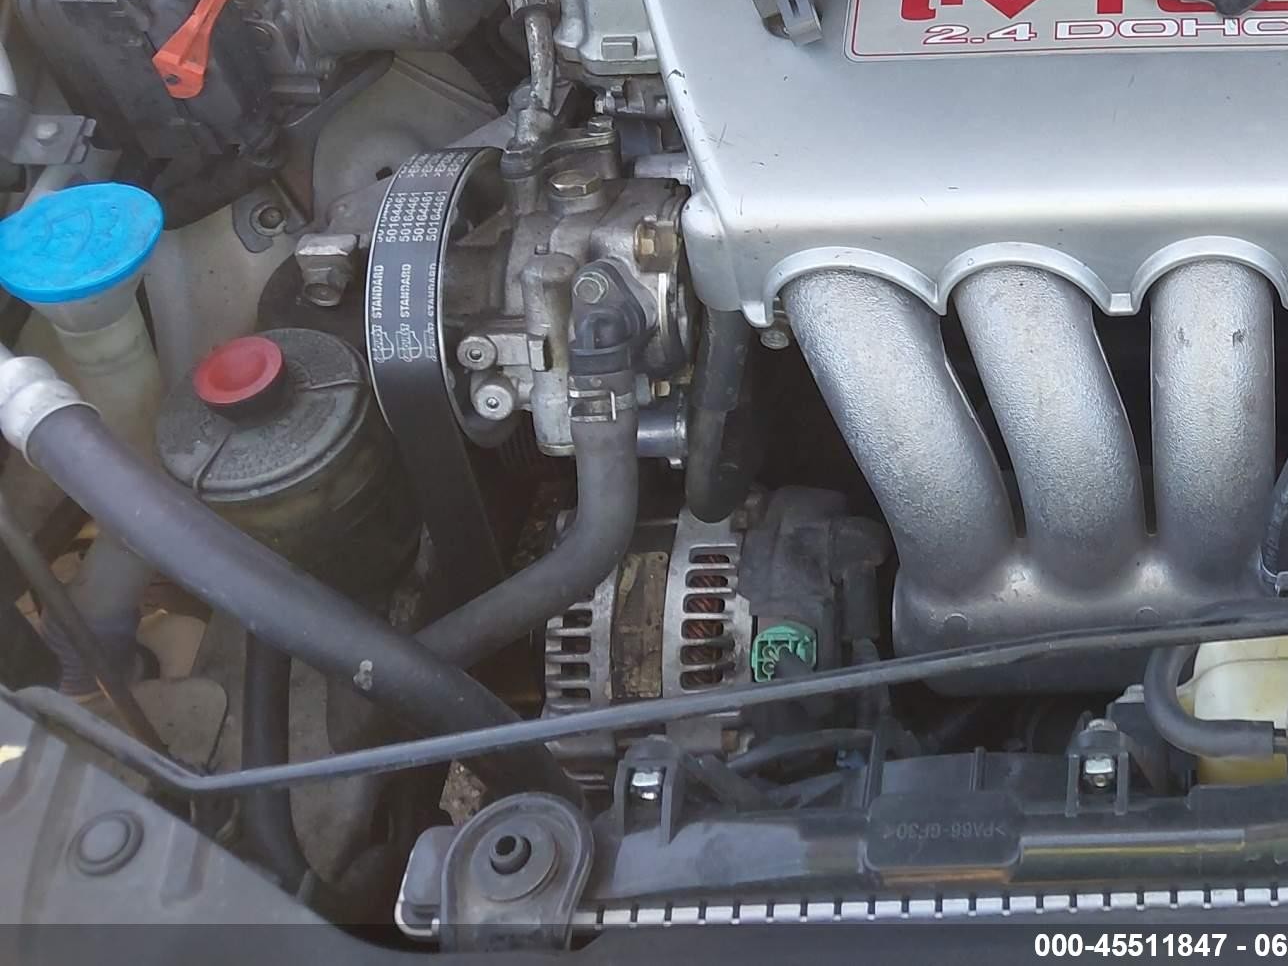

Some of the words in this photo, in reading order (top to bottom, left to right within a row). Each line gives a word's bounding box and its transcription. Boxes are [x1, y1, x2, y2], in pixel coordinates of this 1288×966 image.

[922, 22, 1038, 45] 2.4
[371, 264, 384, 319] STANDARD
[400, 264, 412, 318] STANDARD
